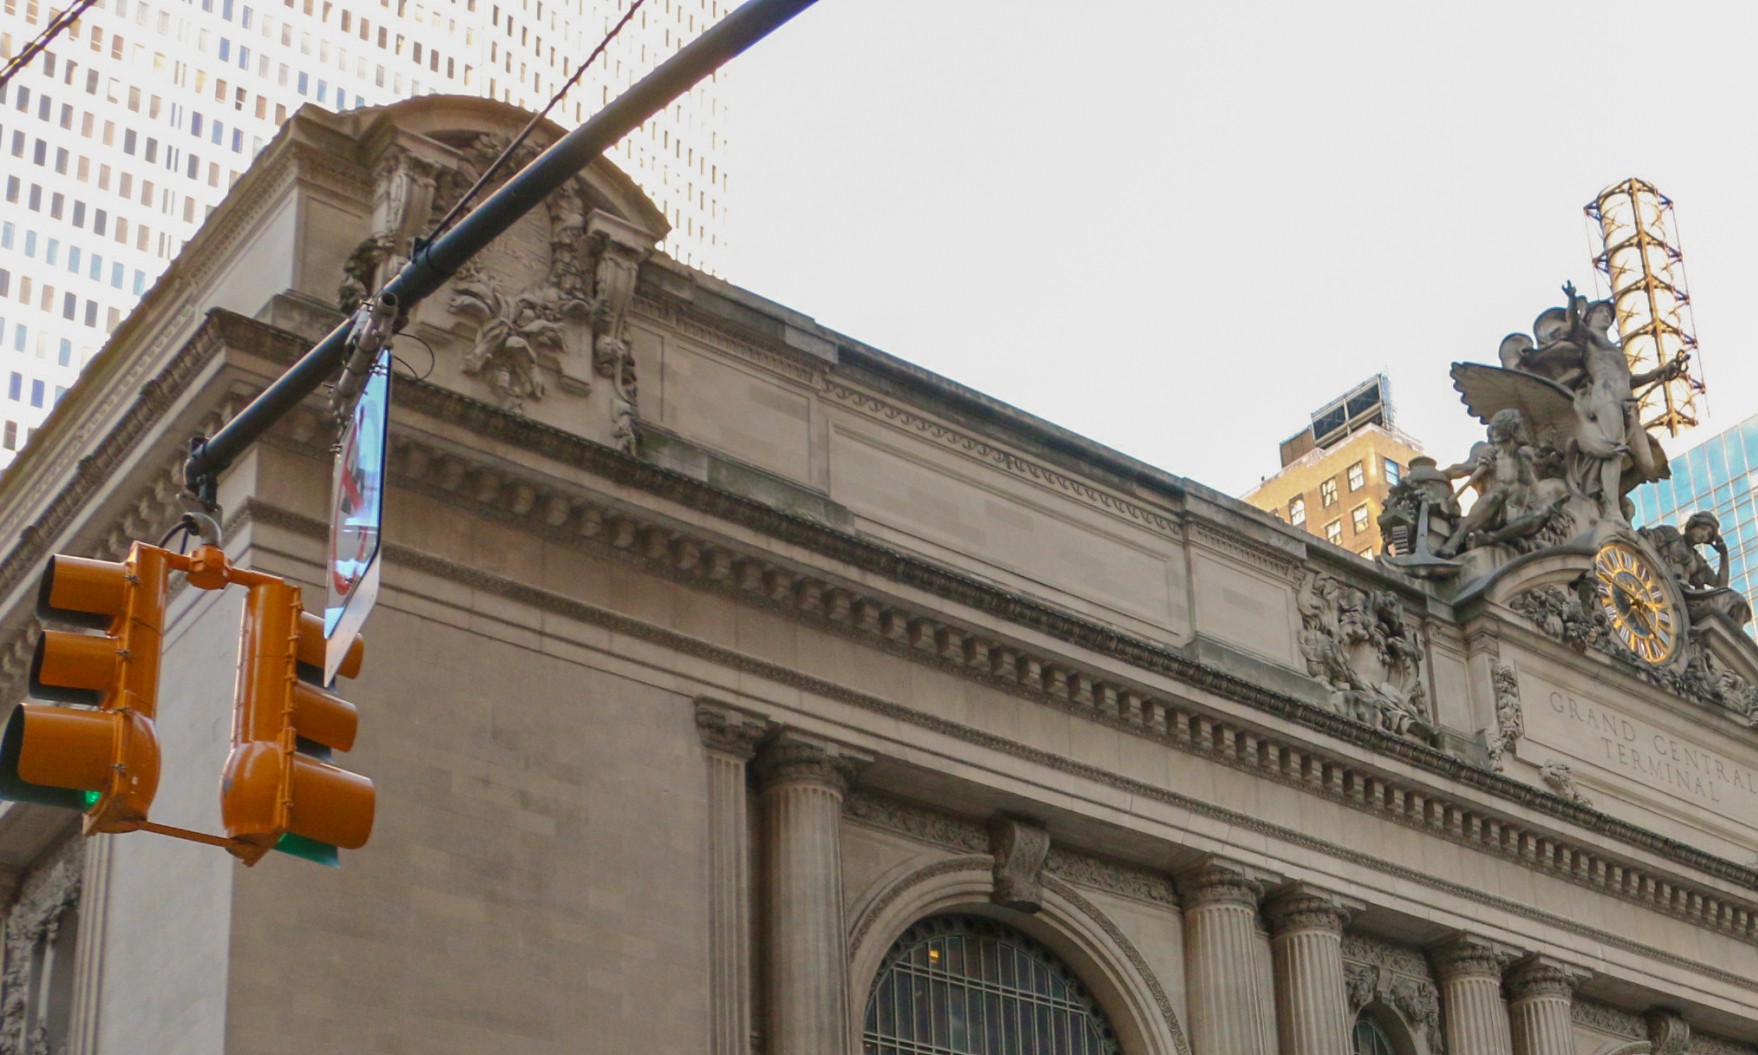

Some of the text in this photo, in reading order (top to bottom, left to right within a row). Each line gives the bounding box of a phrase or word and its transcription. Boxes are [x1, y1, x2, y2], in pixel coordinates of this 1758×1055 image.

[1550, 691, 1758, 794] GRAND CENTRAL
[1600, 736, 1720, 803] TERMINAL
